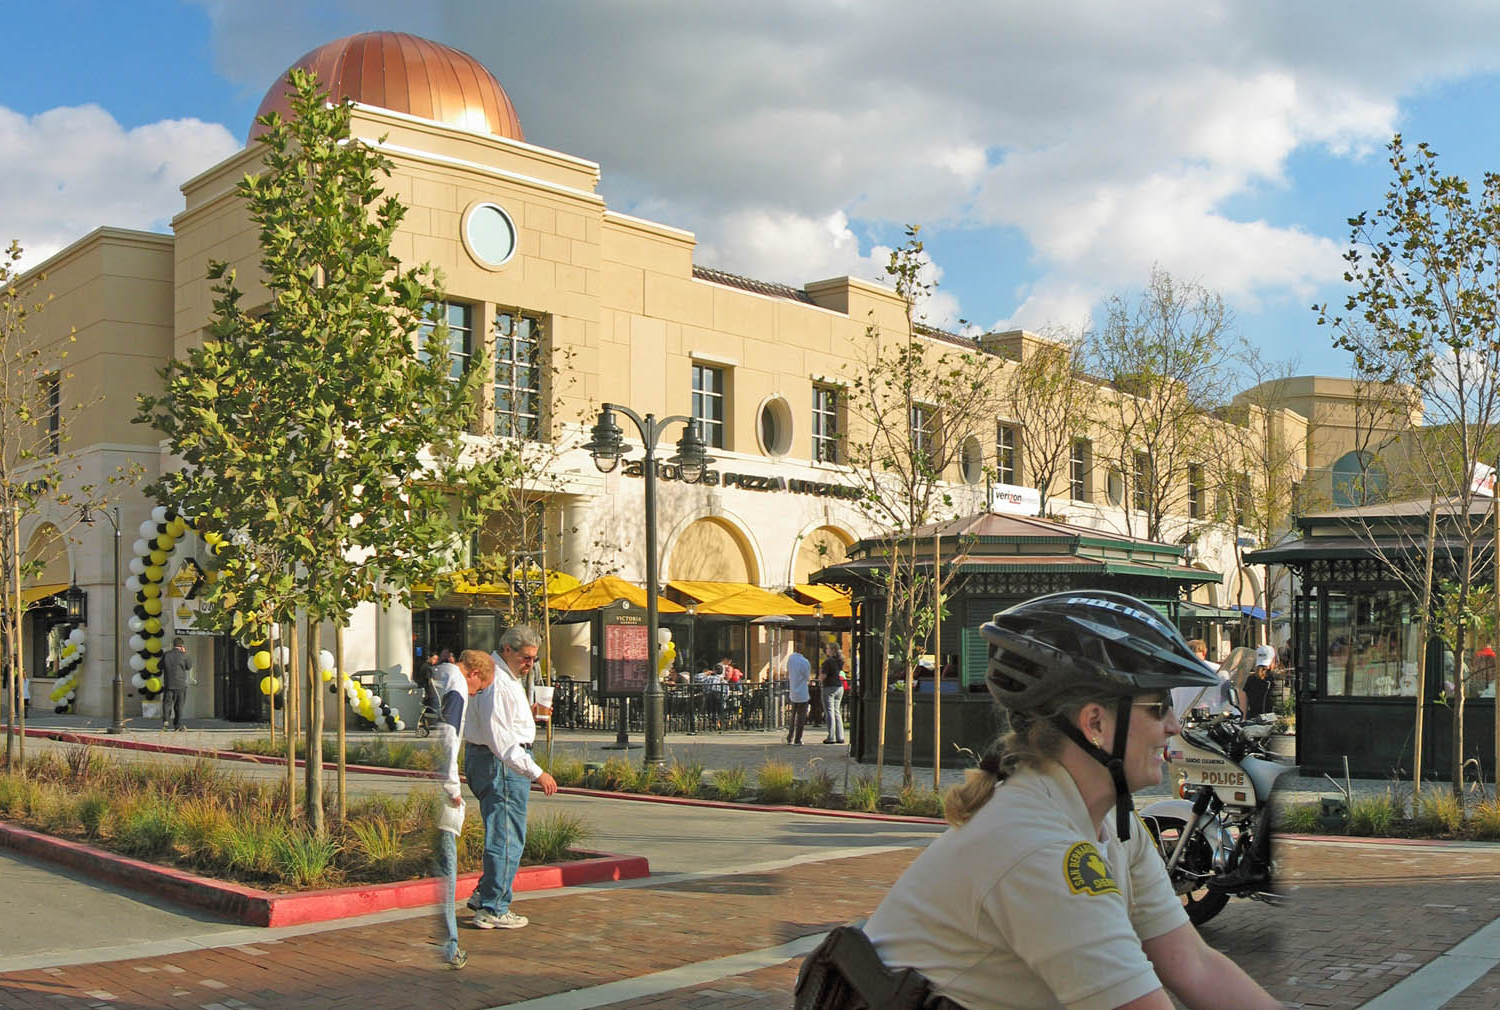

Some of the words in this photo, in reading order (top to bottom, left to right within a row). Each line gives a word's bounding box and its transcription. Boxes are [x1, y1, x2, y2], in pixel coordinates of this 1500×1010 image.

[996, 491, 1021, 504] verizon
[1068, 597, 1174, 638] POLICE
[1202, 772, 1245, 786] POLICE
[1069, 869, 1085, 887] SAN
